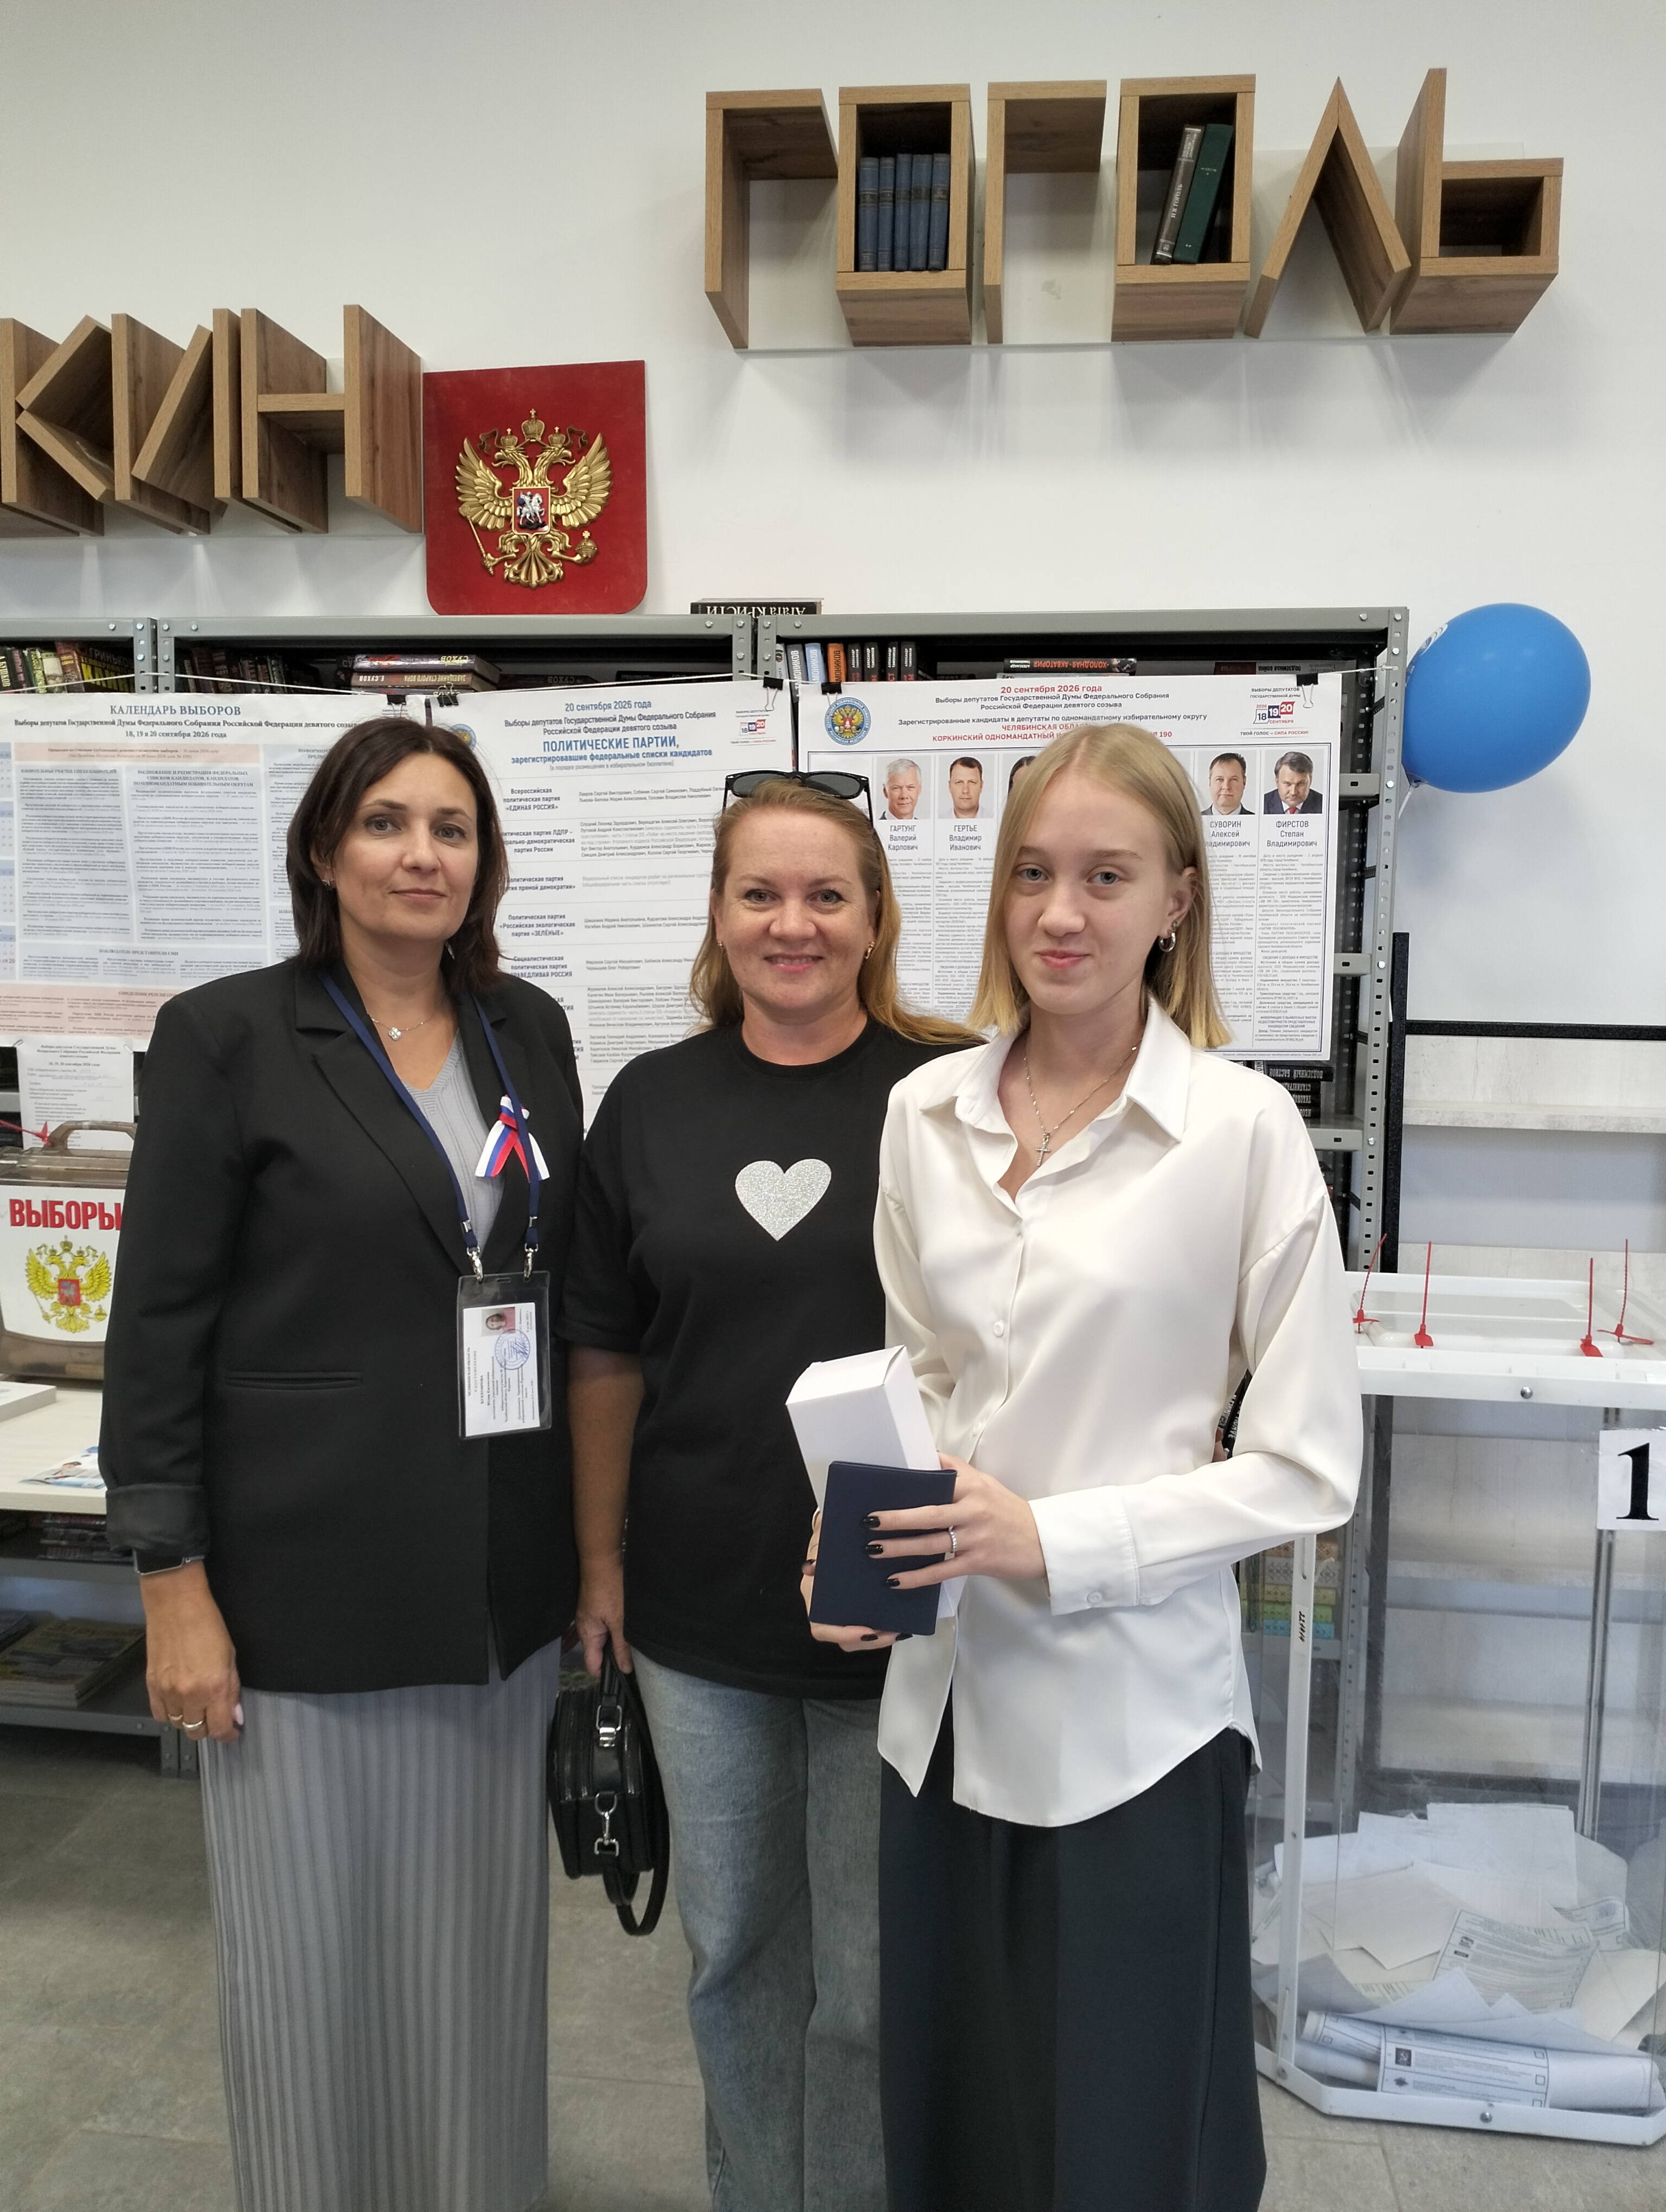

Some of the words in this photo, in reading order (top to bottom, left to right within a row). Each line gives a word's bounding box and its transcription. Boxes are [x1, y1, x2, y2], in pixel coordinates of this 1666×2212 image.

[1173, 184, 1183, 207] ГОГОЛЬ
[706, 67, 1564, 351] ГОГОЛЬ
[706, 606, 767, 619] КРИСТИ
[770, 607, 806, 615] Агата
[810, 650, 819, 683] МОНИКОВ
[437, 674, 466, 682] ЗАВЕЩАНИЕ
[1001, 693, 1060, 704] Государственной
[111, 705, 176, 715] КАЛЕНДАРЬ
[180, 706, 241, 715] ВЫБОРОВ
[565, 703, 574, 711] 20
[576, 702, 612, 711] сентября
[614, 700, 632, 709] 2026
[1269, 708, 1278, 717] 19
[1280, 704, 1293, 712] 20
[564, 715, 617, 725] Государственной
[618, 714, 636, 723] Думы
[638, 713, 683, 721] Федерального
[685, 711, 716, 719] Собрания
[1061, 716, 1121, 724] одномандатному
[68, 719, 116, 727] Государственной
[117, 719, 136, 727] Думы
[264, 721, 303, 729] Федерации
[158, 731, 190, 739] сентября
[543, 726, 581, 735] Российской
[985, 732, 1054, 740] ОДНОМАНДАТНЫЙ
[543, 738, 629, 751] ПОЛИТИЧЕСКИЕ
[633, 736, 678, 748] ПАРТИИ,
[511, 755, 587, 764] зарегистрировавшие
[589, 753, 640, 761] федеральные
[890, 834, 916, 842] Валерий
[1269, 1069, 1290, 1077] БАСТИОН
[1293, 1069, 1323, 1079] ПОДЗЕМНЫЙ
[1282, 1083, 1311, 1091] СТАЛИНГРАД
[10, 1198, 123, 1230] ВЫБОРЫ
[1616, 1442, 1659, 1520] 1
